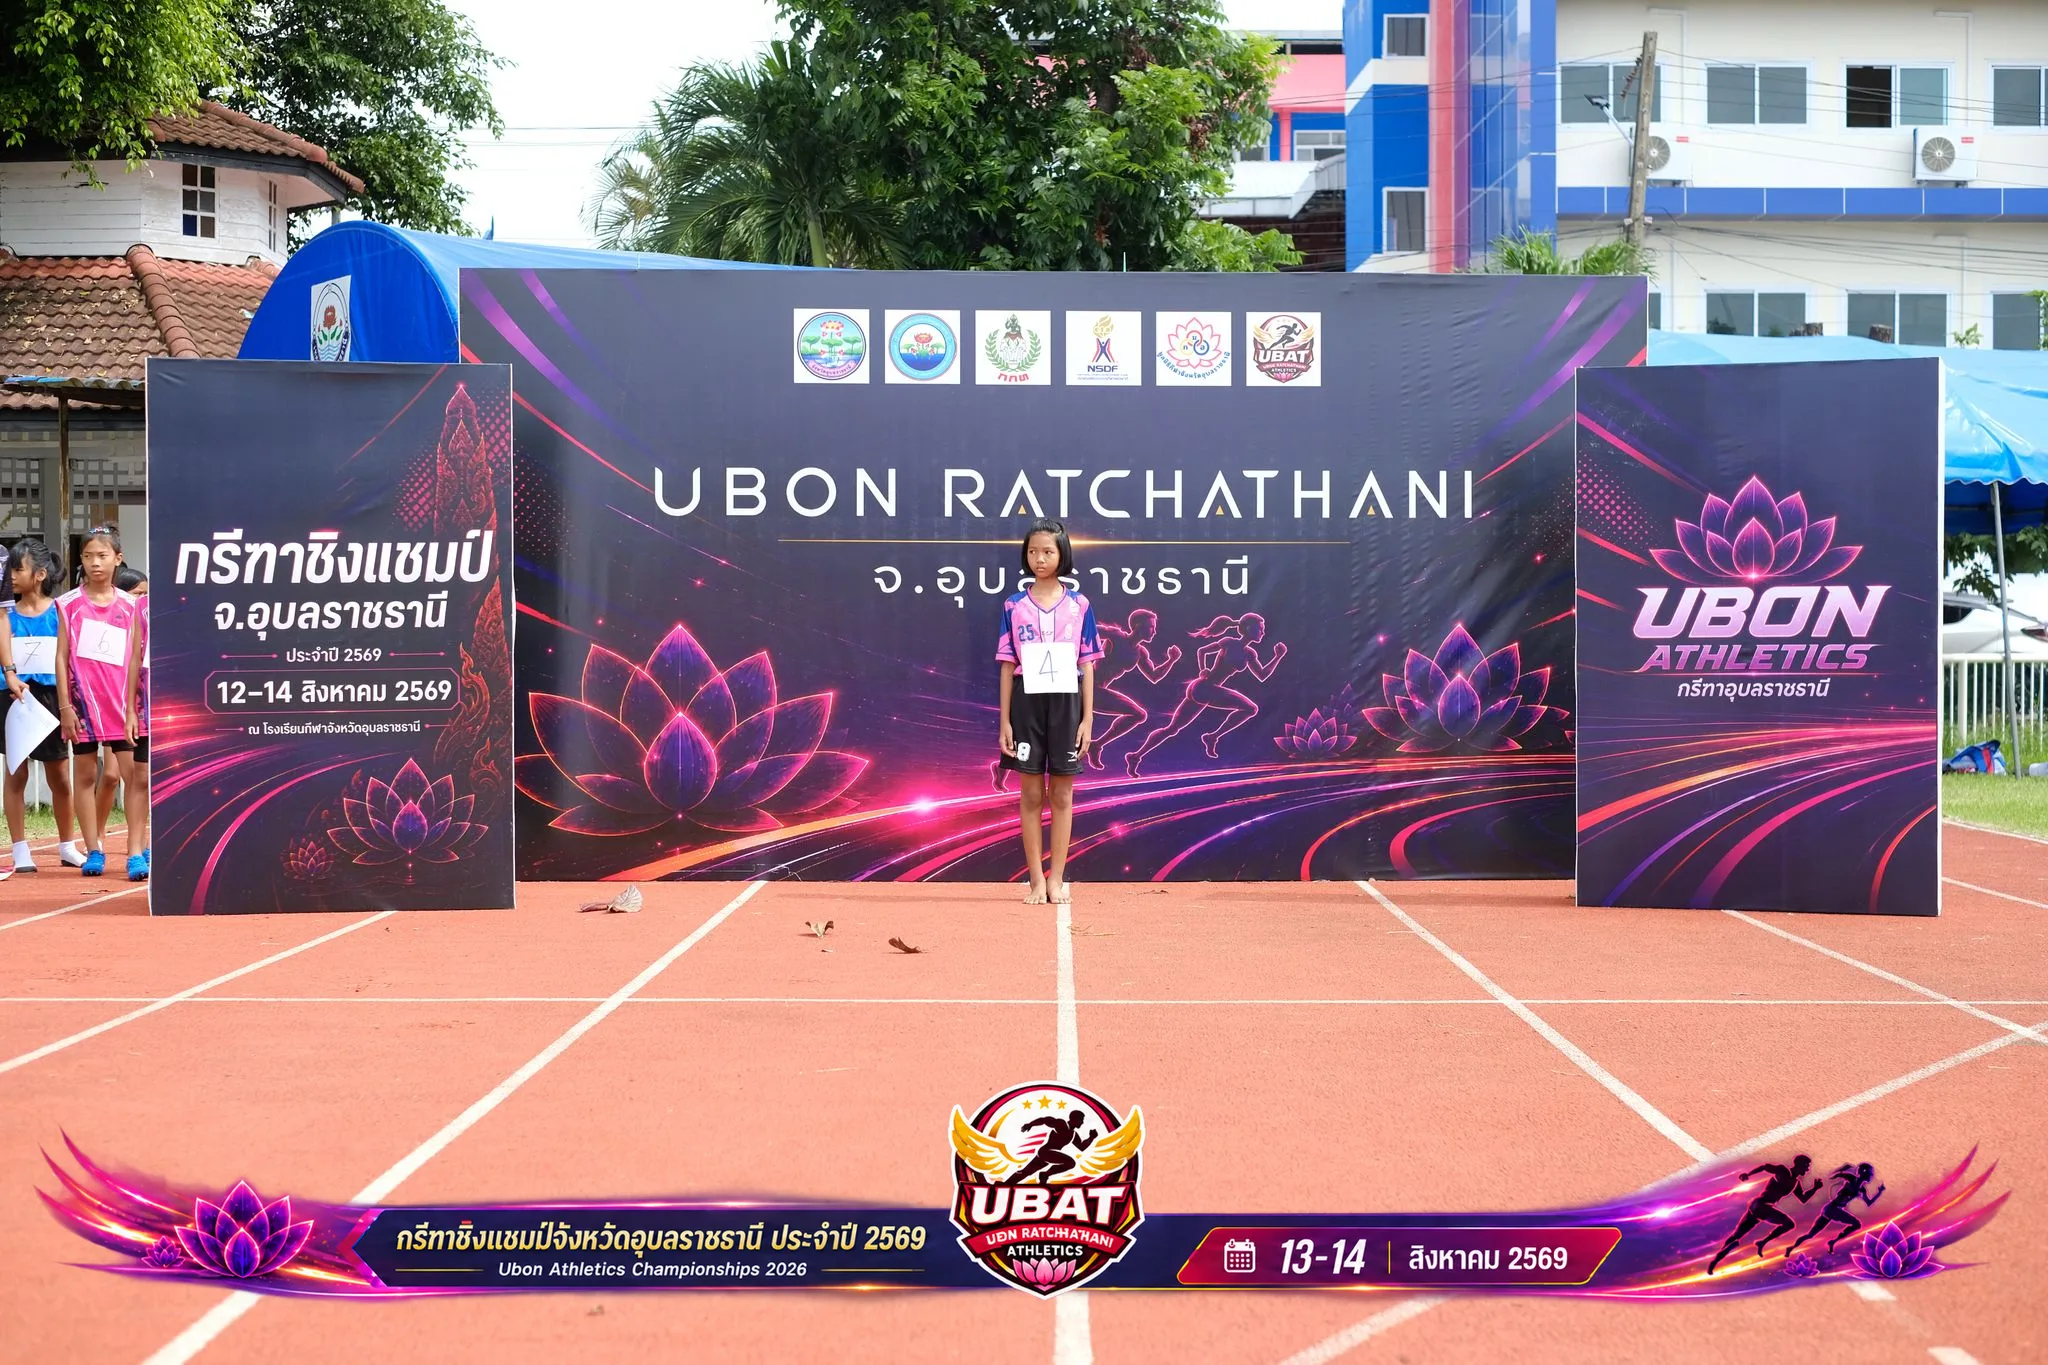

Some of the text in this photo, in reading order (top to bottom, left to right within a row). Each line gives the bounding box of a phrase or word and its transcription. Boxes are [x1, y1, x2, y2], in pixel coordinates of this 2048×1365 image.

[1087, 364, 1119, 373] NSDF
[1258, 350, 1309, 363] UBAT
[654, 466, 1473, 519] UBON RATCHATHANI
[175, 528, 494, 585] กรีฑาชิงแชมป์
[214, 590, 449, 641] จ.อุบลราชธานี
[1633, 585, 1892, 638] UBON
[1018, 624, 1034, 641] 25
[23, 641, 42, 666] 7
[286, 646, 382, 663] ประจำปี 2569
[1038, 649, 1059, 683] 4
[1637, 643, 1876, 670] ATHLETICS
[301, 679, 387, 703] สิงหาคม
[395, 680, 452, 701] 2569
[1677, 677, 1831, 703] กรีฑาอุบลราชธานี
[248, 725, 260, 735] ณ
